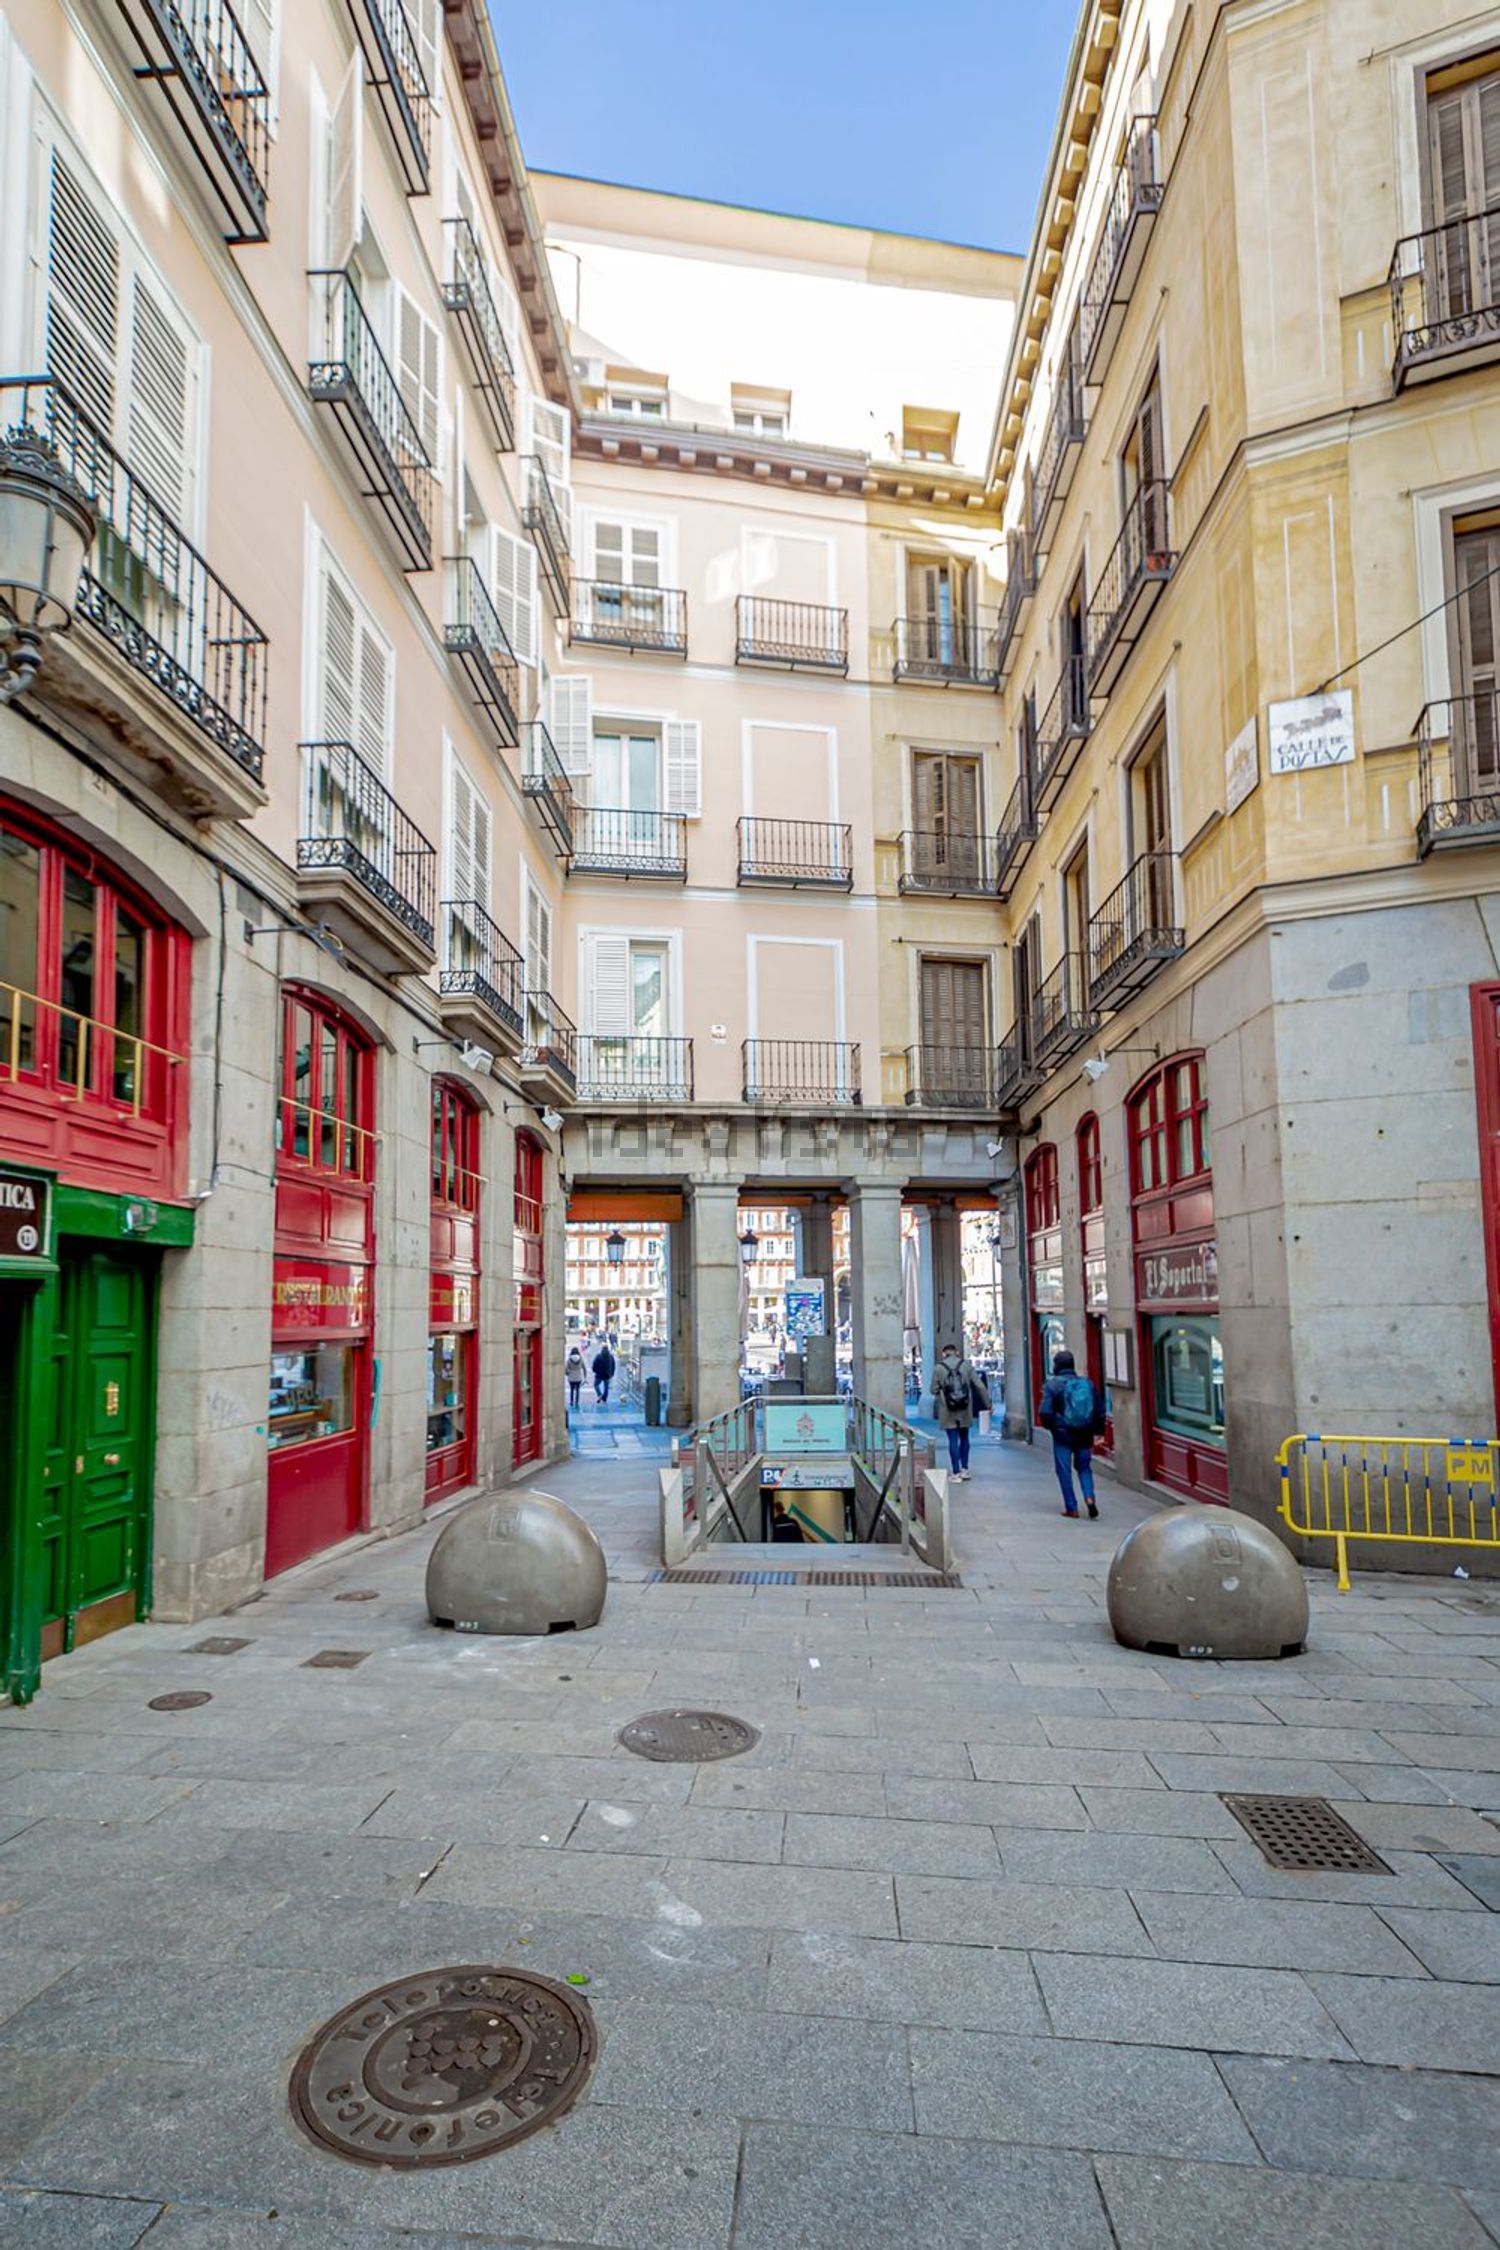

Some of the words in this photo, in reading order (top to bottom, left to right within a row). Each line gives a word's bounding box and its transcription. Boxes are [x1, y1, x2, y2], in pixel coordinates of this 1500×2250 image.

[1277, 737, 1326, 755] CALLE
[1280, 745, 1348, 769] POSTAS
[1451, 1459, 1489, 1475] PM
